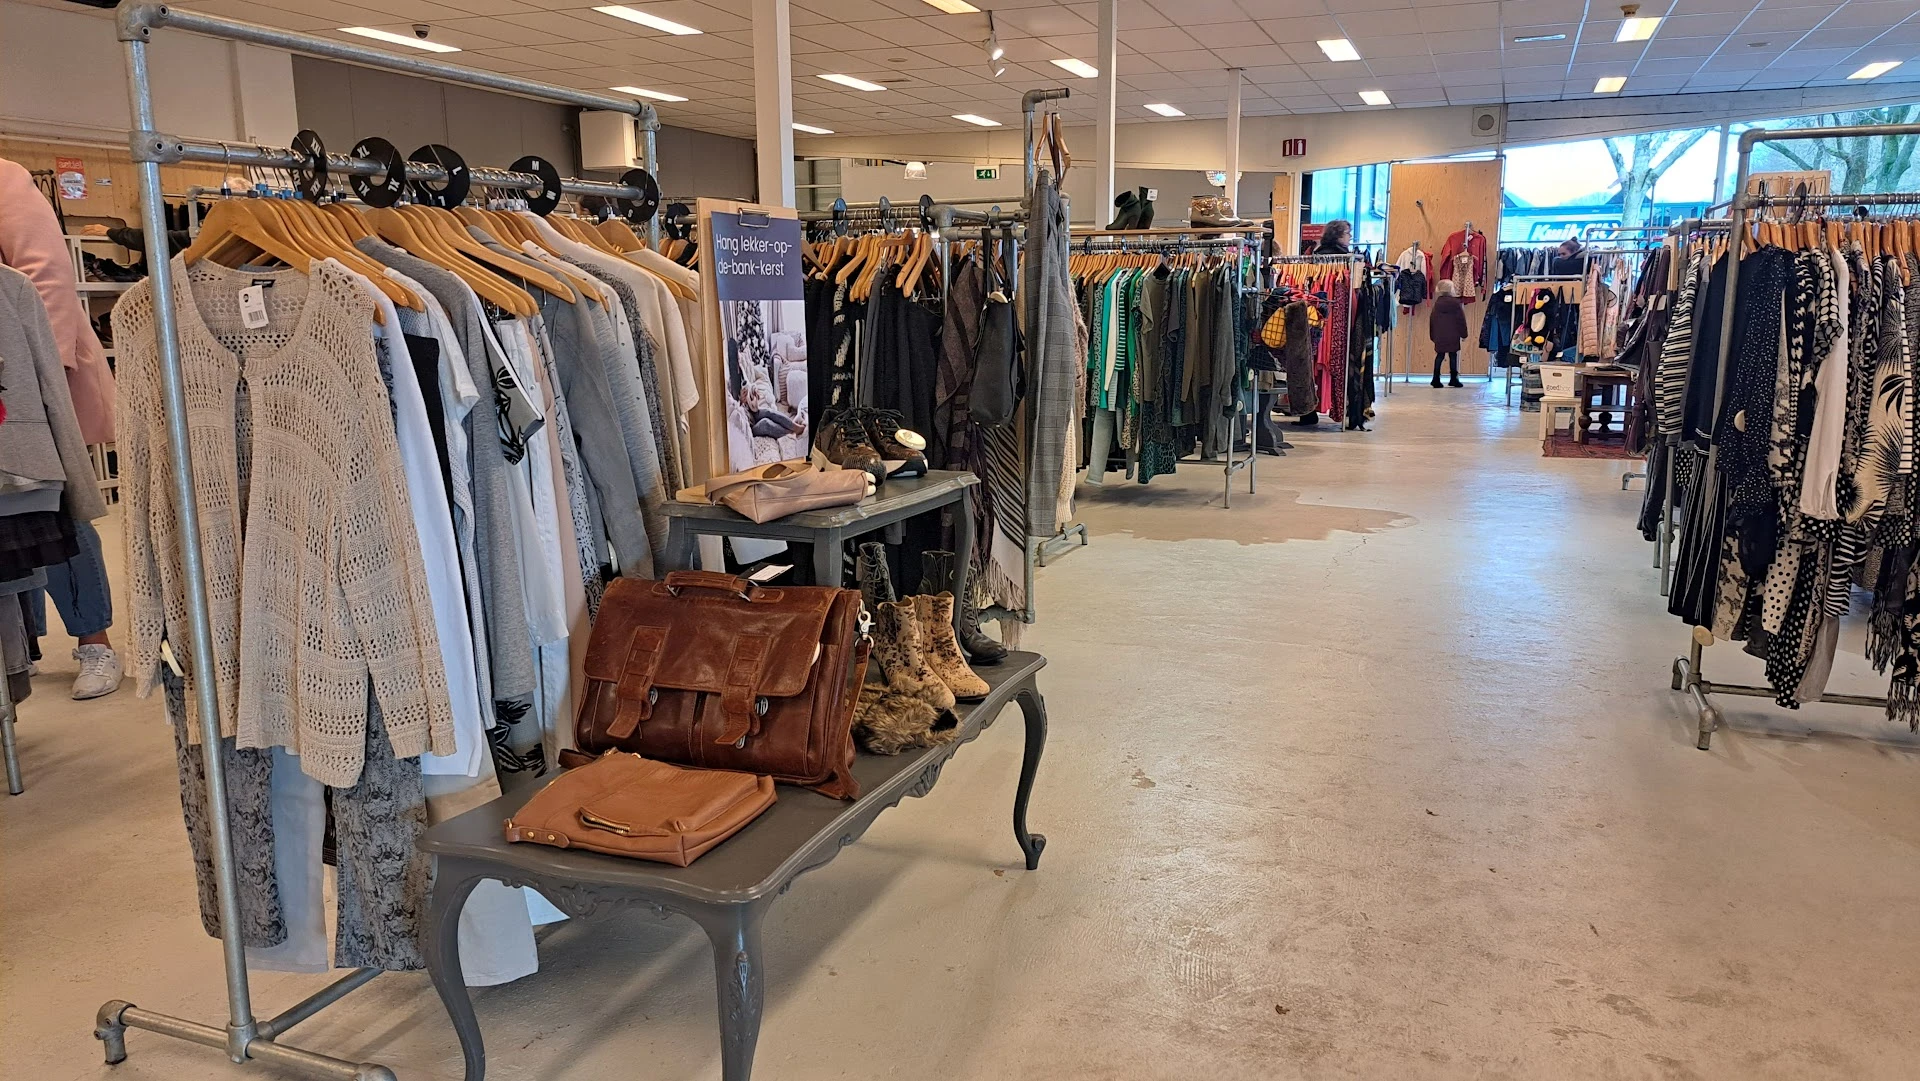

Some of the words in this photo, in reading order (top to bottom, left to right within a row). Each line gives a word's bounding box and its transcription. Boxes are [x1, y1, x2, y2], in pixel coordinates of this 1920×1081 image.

[357, 145, 370, 159] XL
[452, 166, 462, 176] L
[531, 160, 540, 171] M
[358, 180, 370, 197] XL
[388, 178, 400, 192] XL
[438, 195, 446, 207] L
[546, 190, 557, 201] M
[627, 209, 634, 218] S
[716, 233, 739, 256] Hang
[740, 235, 792, 258] lekker-op-
[717, 258, 785, 276] de-bank-kerst
